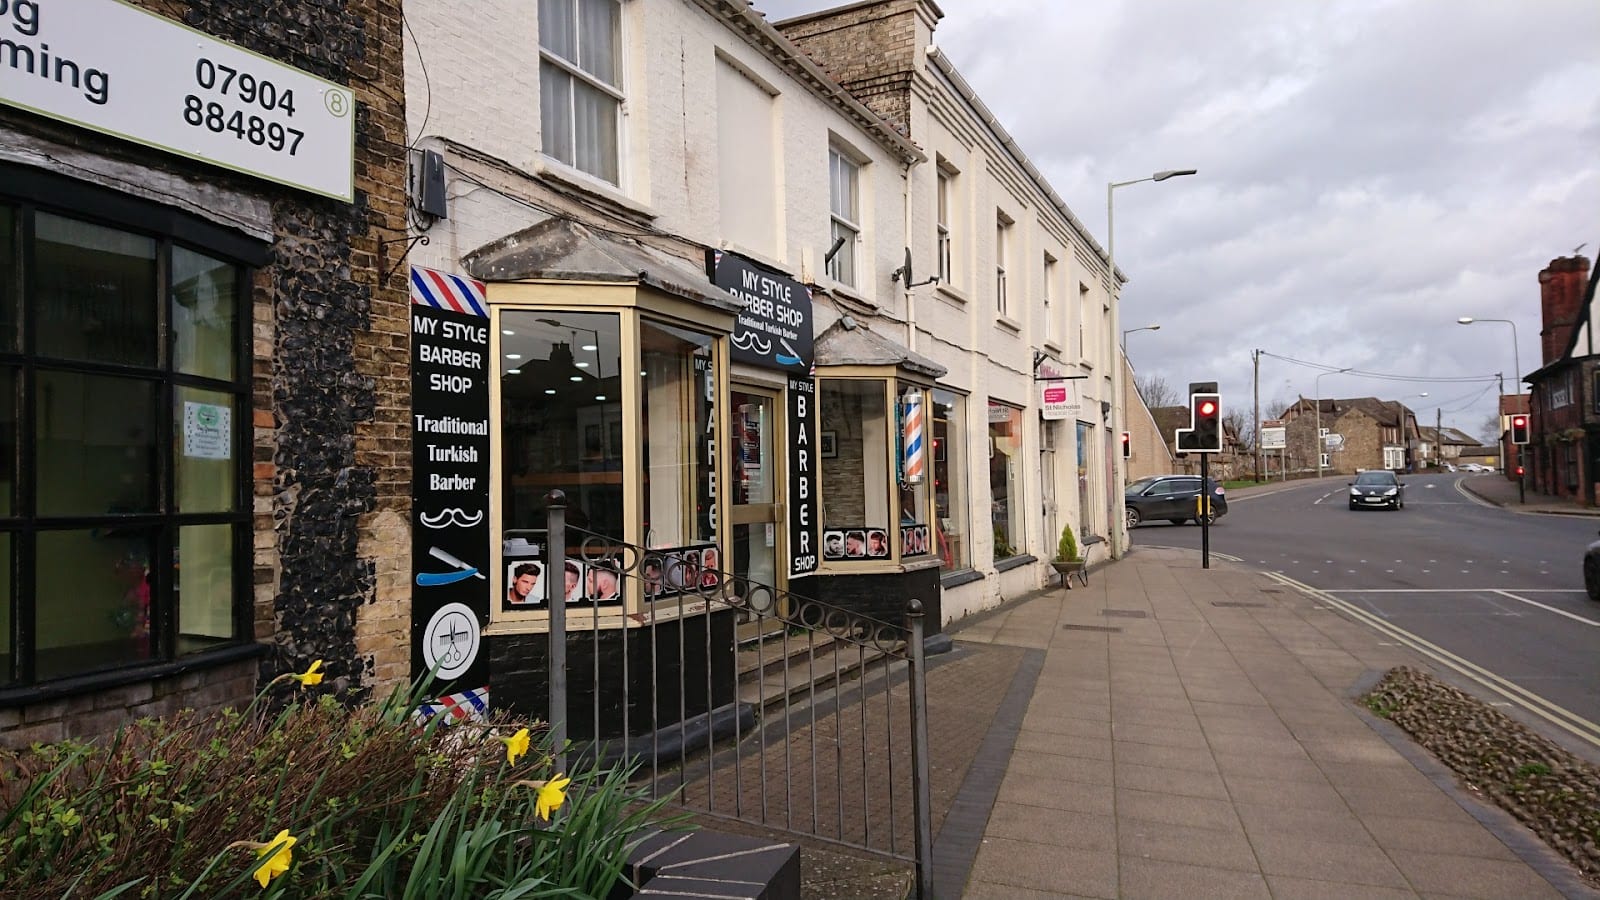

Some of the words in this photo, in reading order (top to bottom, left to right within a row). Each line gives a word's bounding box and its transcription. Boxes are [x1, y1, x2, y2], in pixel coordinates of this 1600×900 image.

[195, 57, 296, 118] 07904
[182, 94, 305, 156] 884897
[742, 269, 759, 292] MY
[761, 276, 792, 304] STYLE
[738, 314, 765, 331] Traditional
[765, 321, 783, 336] Turkish
[782, 327, 798, 340] Barber
[776, 304, 803, 328] SHOP
[414, 315, 438, 335] MY
[442, 321, 487, 345] STYLE
[420, 344, 482, 369] BARBER
[695, 358, 706, 371] MY
[430, 374, 473, 393] SHOP
[790, 379, 798, 390] MY
[798, 380, 814, 393] STYLE
[415, 414, 488, 435] Traditional
[427, 444, 478, 463] Turkish
[430, 473, 476, 491] Barber
[797, 395, 810, 554] BARBER
[794, 555, 816, 571] SHOP
